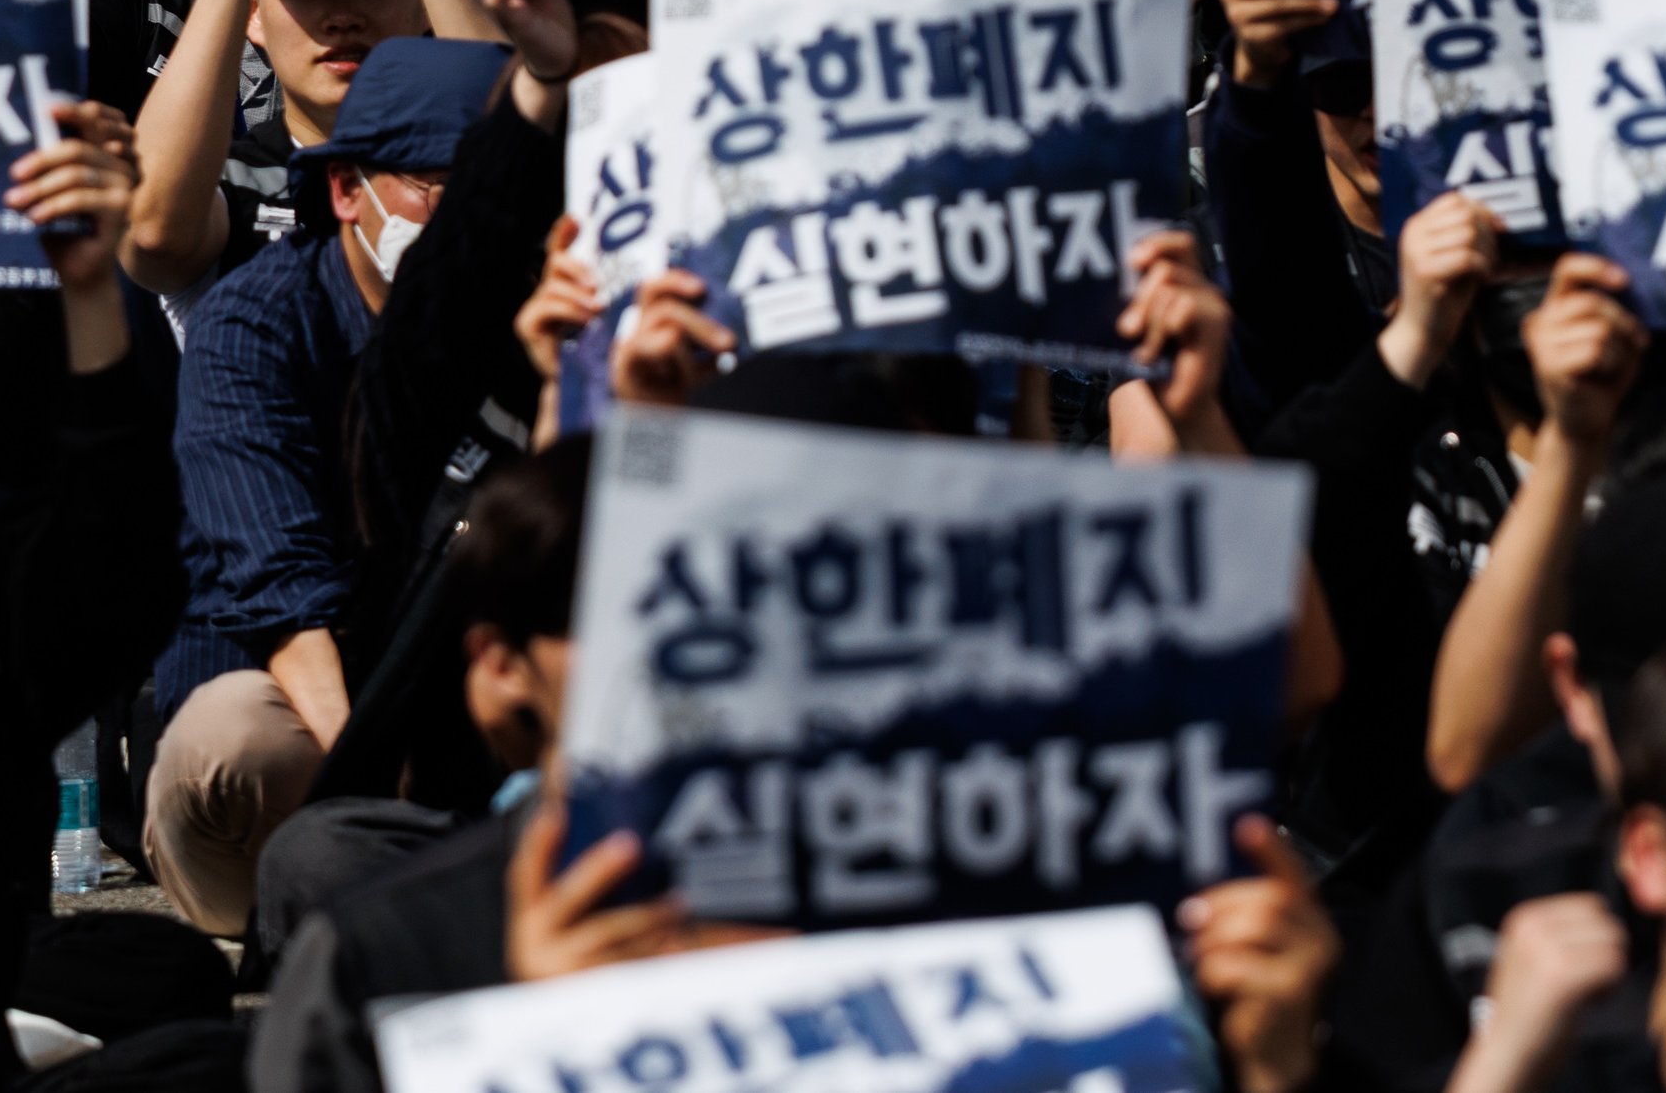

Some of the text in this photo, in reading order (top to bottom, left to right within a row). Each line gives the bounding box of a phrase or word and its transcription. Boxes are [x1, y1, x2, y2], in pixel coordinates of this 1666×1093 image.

[728, 179, 1148, 352] 실현하자
[641, 479, 1217, 685] 상한폐지
[658, 722, 1275, 919] 실현하자
